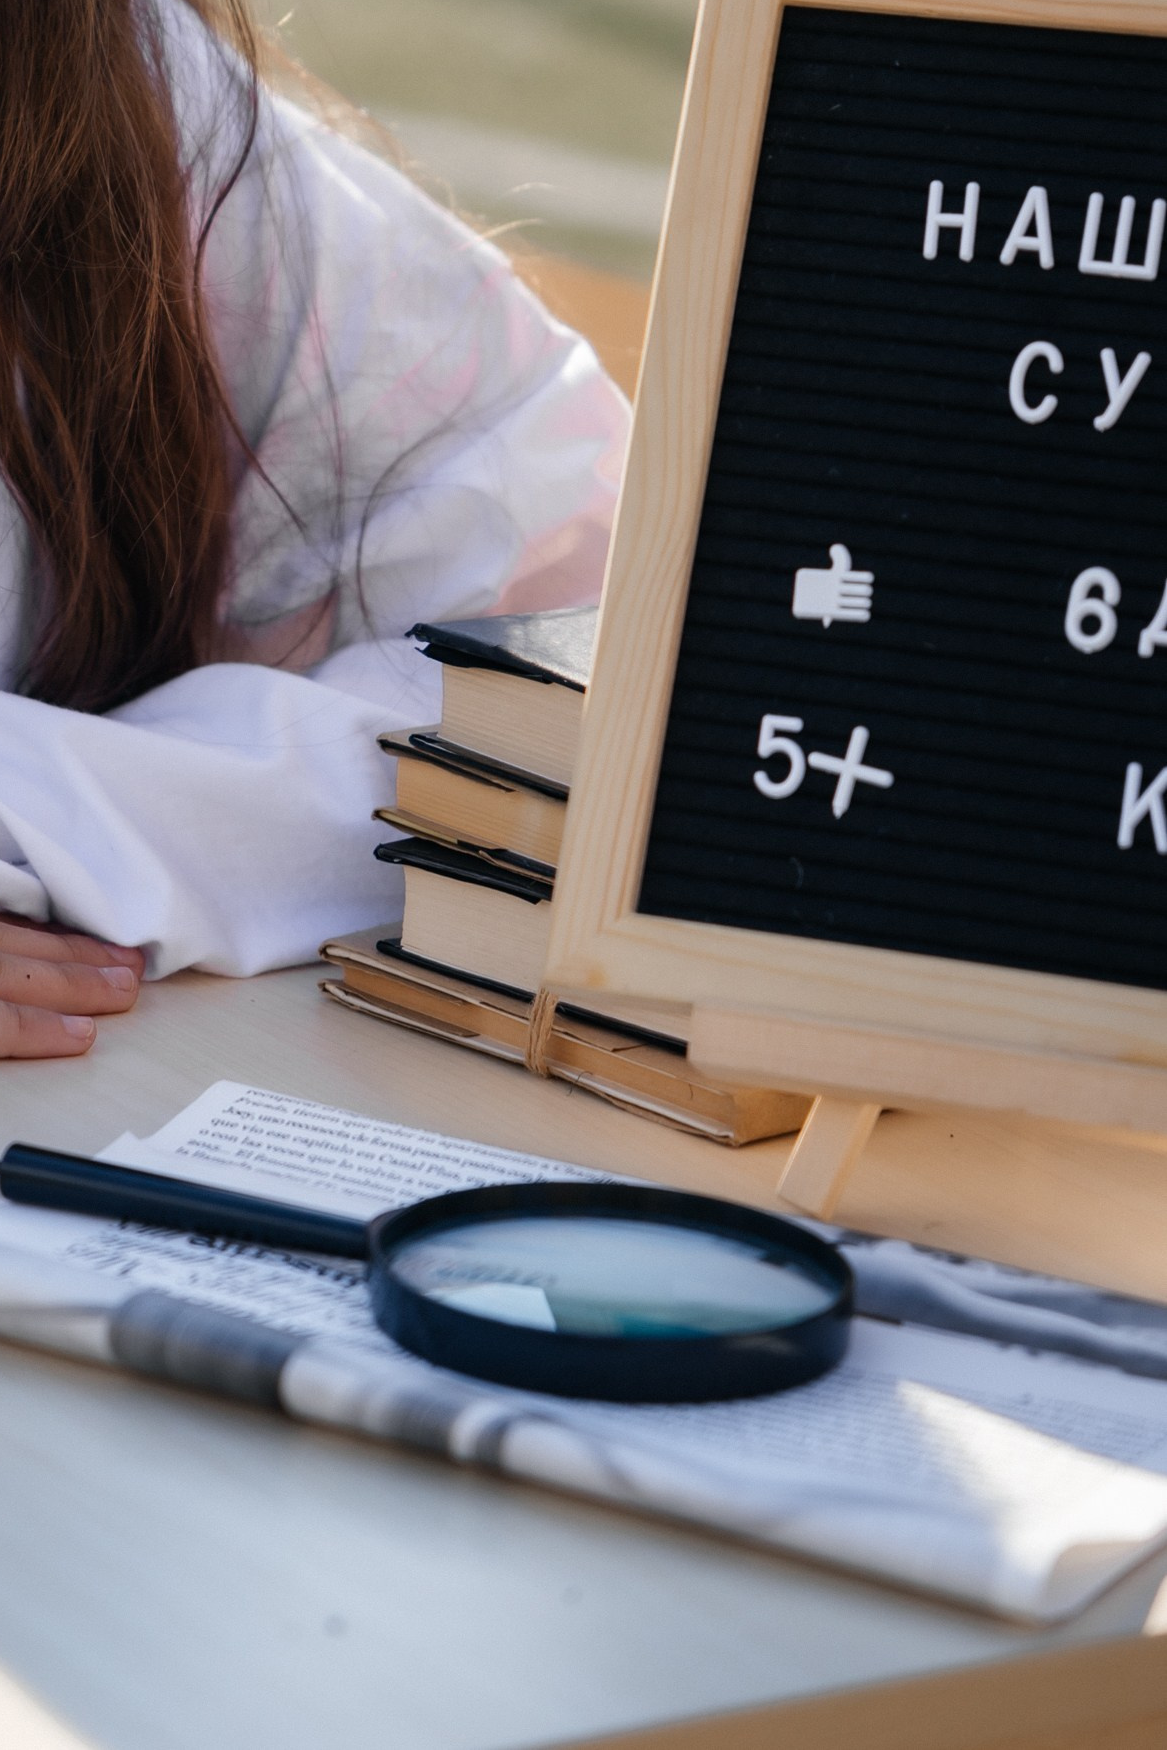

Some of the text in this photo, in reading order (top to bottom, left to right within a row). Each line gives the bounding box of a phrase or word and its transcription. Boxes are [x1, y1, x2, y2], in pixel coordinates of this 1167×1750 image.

[922, 179, 1167, 281] НАШ
[1008, 340, 1152, 432] СУ
[752, 713, 894, 819] 5+
[211, 1131, 238, 1144] con
[241, 1136, 263, 1149] las
[211, 1117, 239, 1129] que
[266, 1129, 290, 1140] ese
[378, 1153, 425, 1171] Canal
